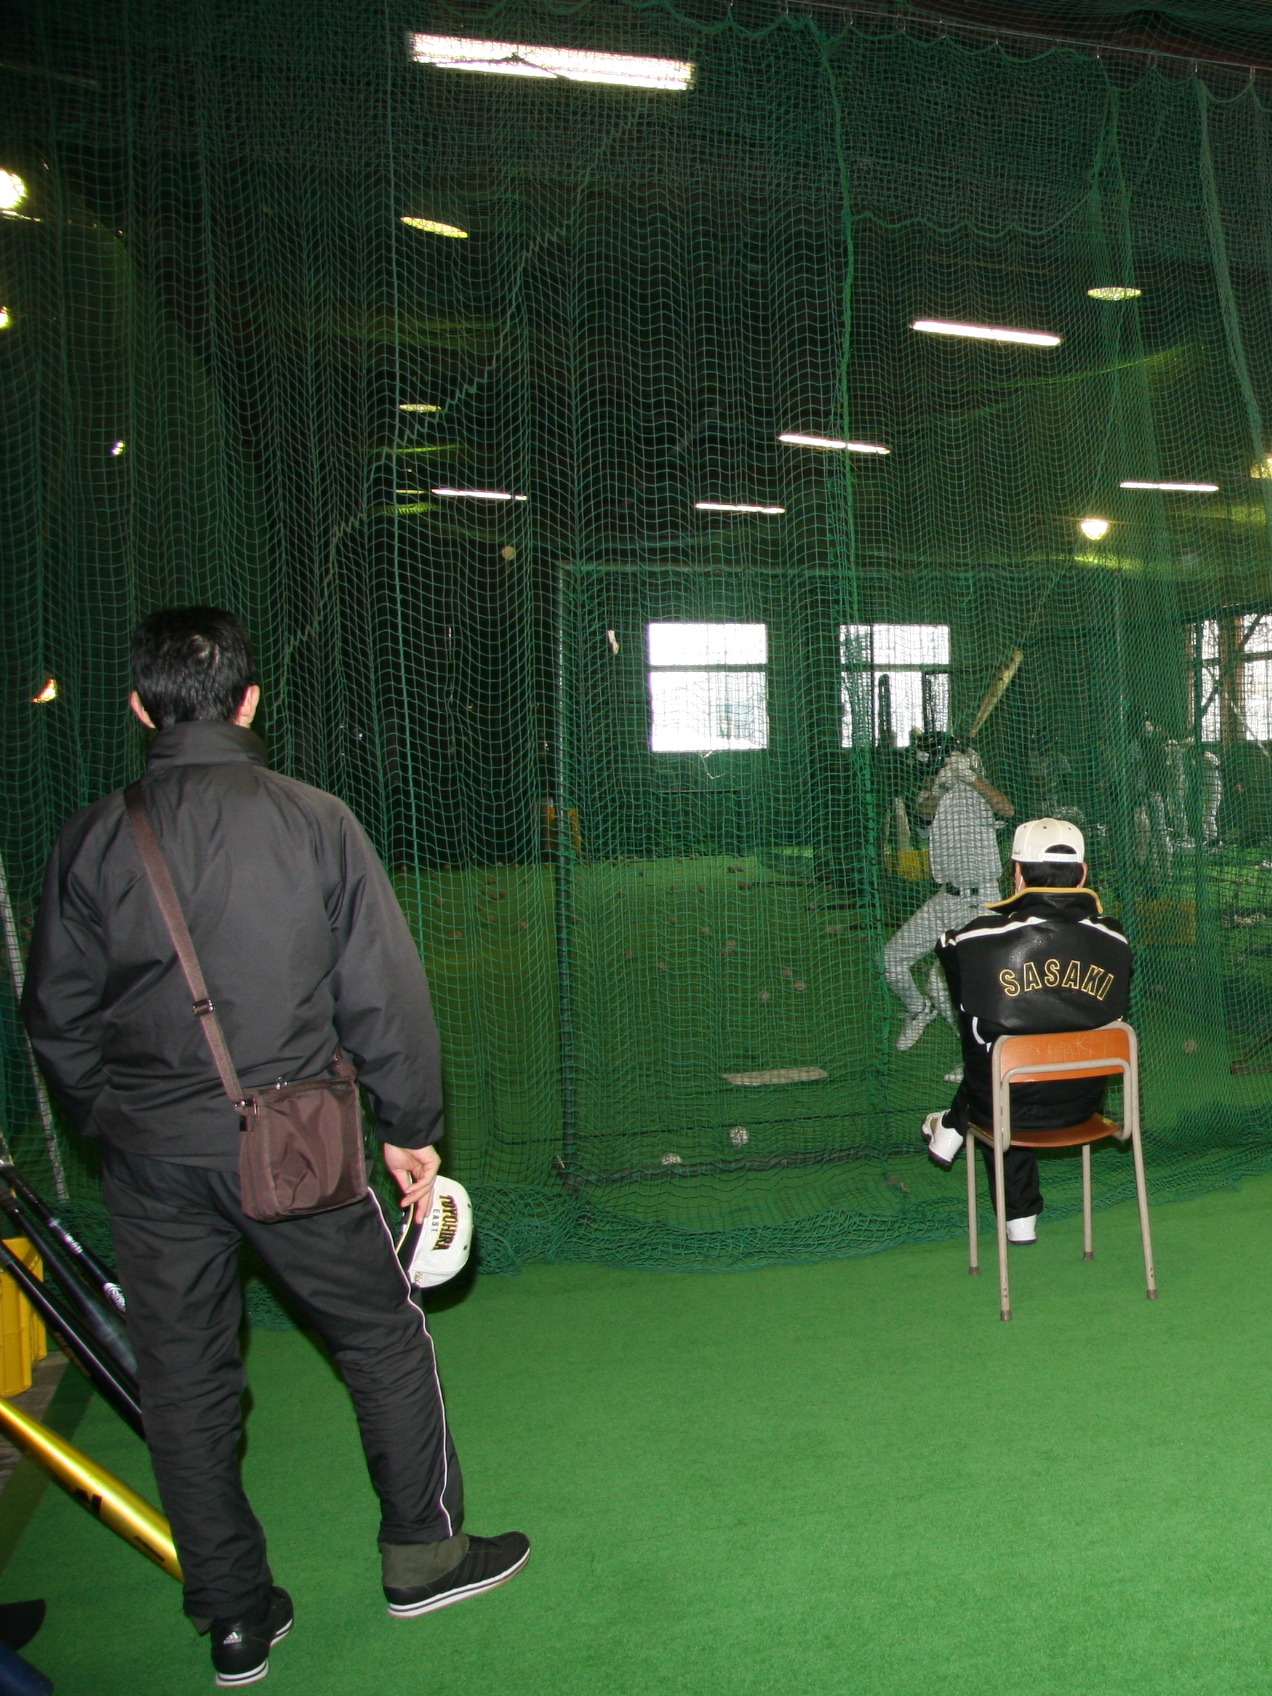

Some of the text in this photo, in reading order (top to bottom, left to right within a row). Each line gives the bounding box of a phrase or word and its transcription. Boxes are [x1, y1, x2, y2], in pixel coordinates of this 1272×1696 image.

[999, 958, 1114, 1001] SASAKI
[431, 1208, 440, 1232] EAST
[432, 1194, 459, 1251] TOYOHIRA
